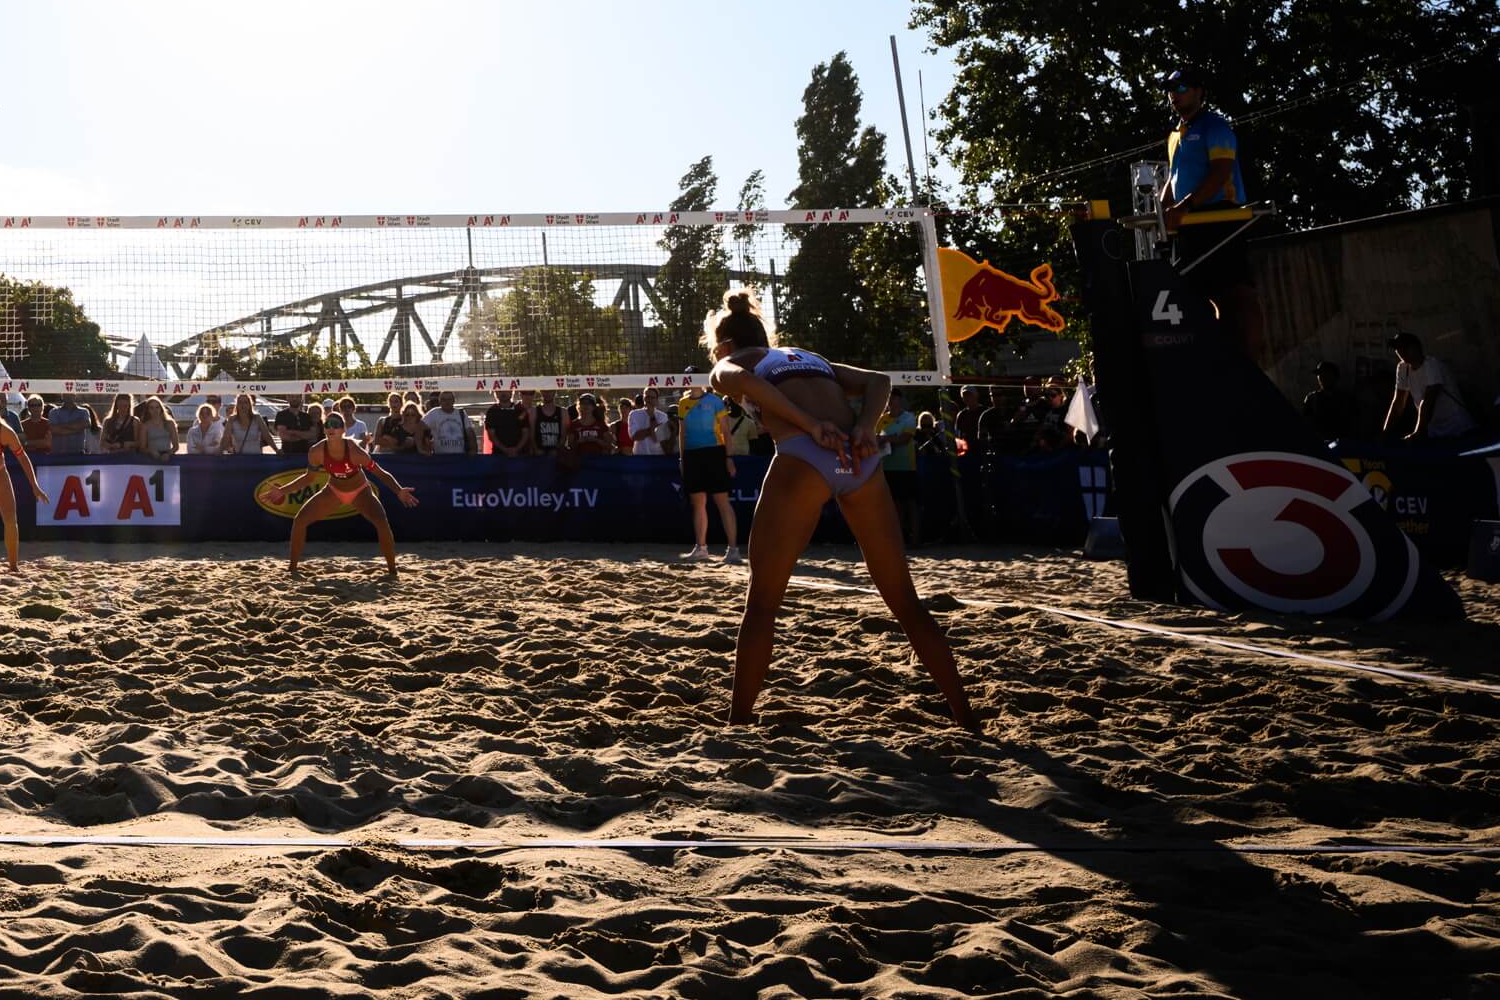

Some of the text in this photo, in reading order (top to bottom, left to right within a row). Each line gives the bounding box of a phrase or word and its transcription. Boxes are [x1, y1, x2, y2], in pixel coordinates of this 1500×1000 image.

[298, 216, 342, 226] A1 A1 A1
[467, 216, 510, 226] A1 A1 A1
[636, 213, 679, 224] A1 A1 A1
[805, 211, 849, 221] A1 A1 A1
[4, 217, 15, 227] A1
[21, 217, 31, 227] A1
[157, 217, 200, 227] A1 A1 A1
[1151, 289, 1184, 325] 4
[476, 379, 520, 390] A1 A1 A1
[648, 376, 692, 387] A1 A1 A1
[2, 382, 12, 392] A1
[18, 382, 29, 392] A1
[157, 383, 201, 393] A1 A1 A1
[304, 382, 348, 392] A1 A1 A1
[53, 469, 164, 520] A1 A1
[452, 488, 599, 512] EuroVolley.TV
[1396, 496, 1428, 515] CEV
